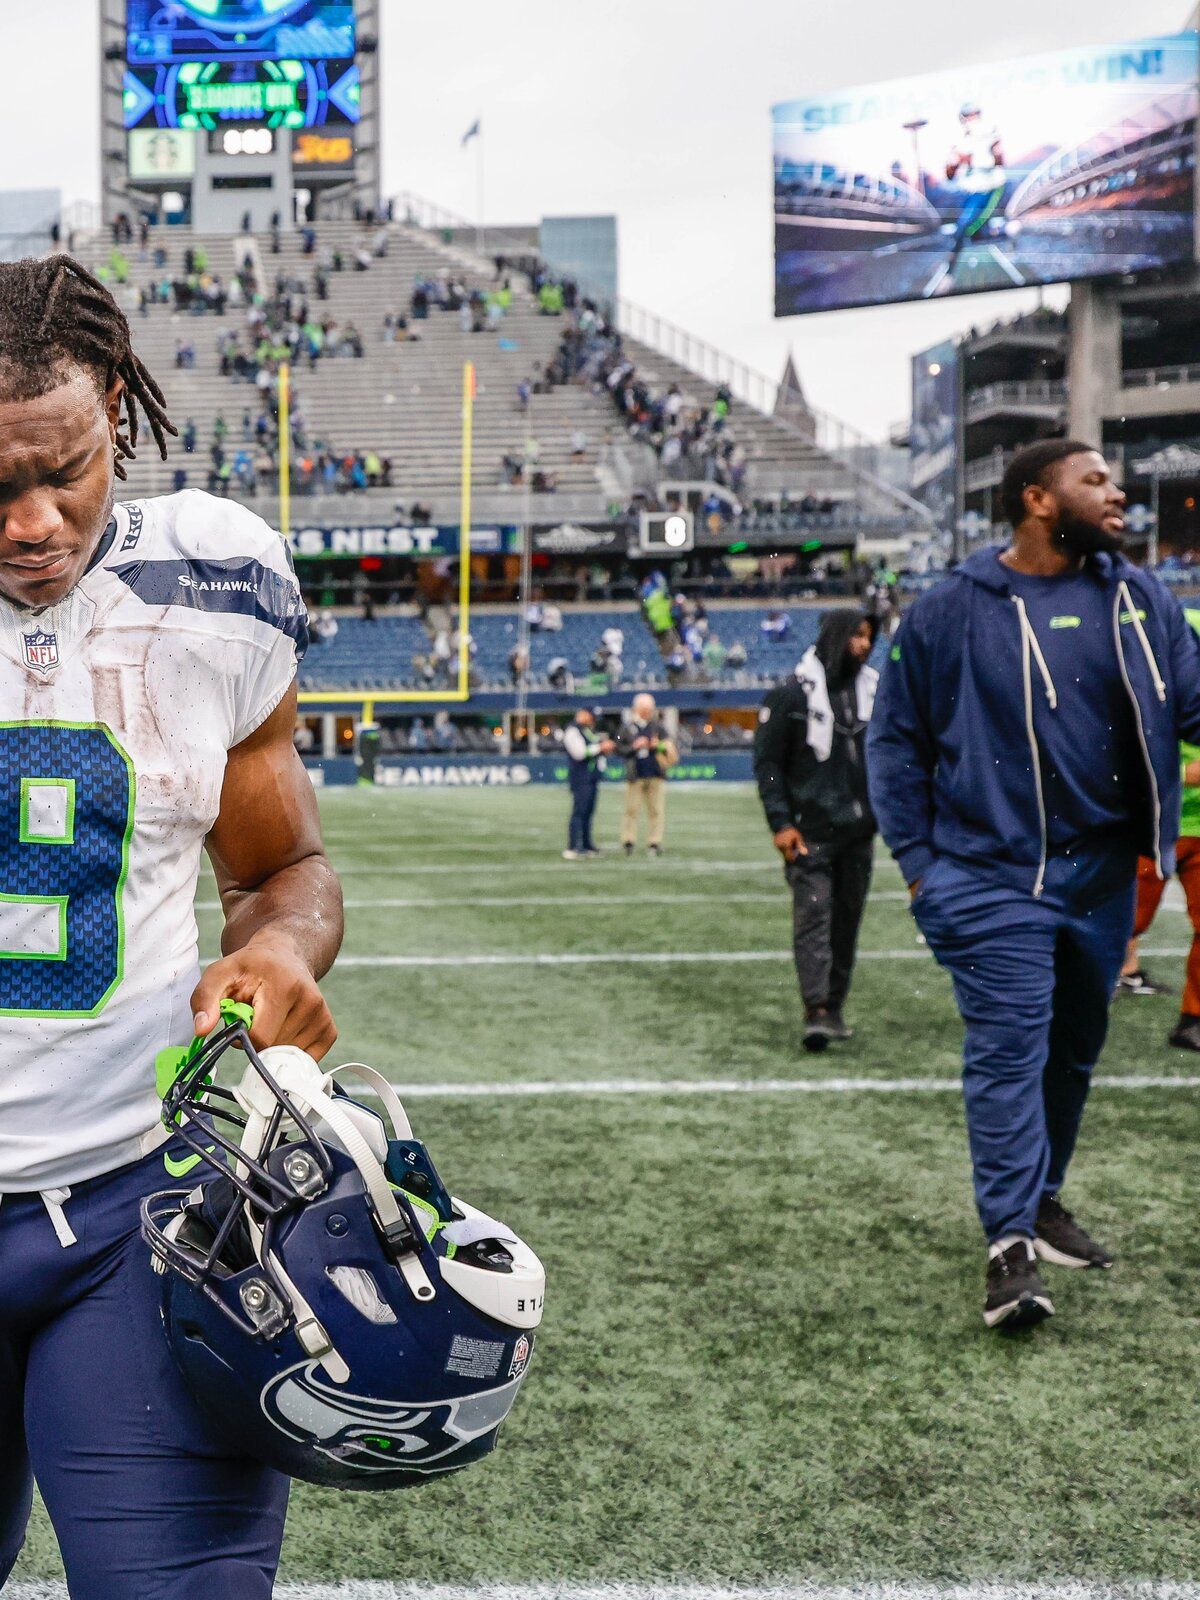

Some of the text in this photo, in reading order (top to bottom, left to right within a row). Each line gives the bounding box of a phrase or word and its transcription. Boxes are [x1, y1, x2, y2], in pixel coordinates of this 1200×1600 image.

[1061, 48, 1164, 84] WIN!
[331, 527, 438, 554] NEST
[29, 646, 56, 664] NFL
